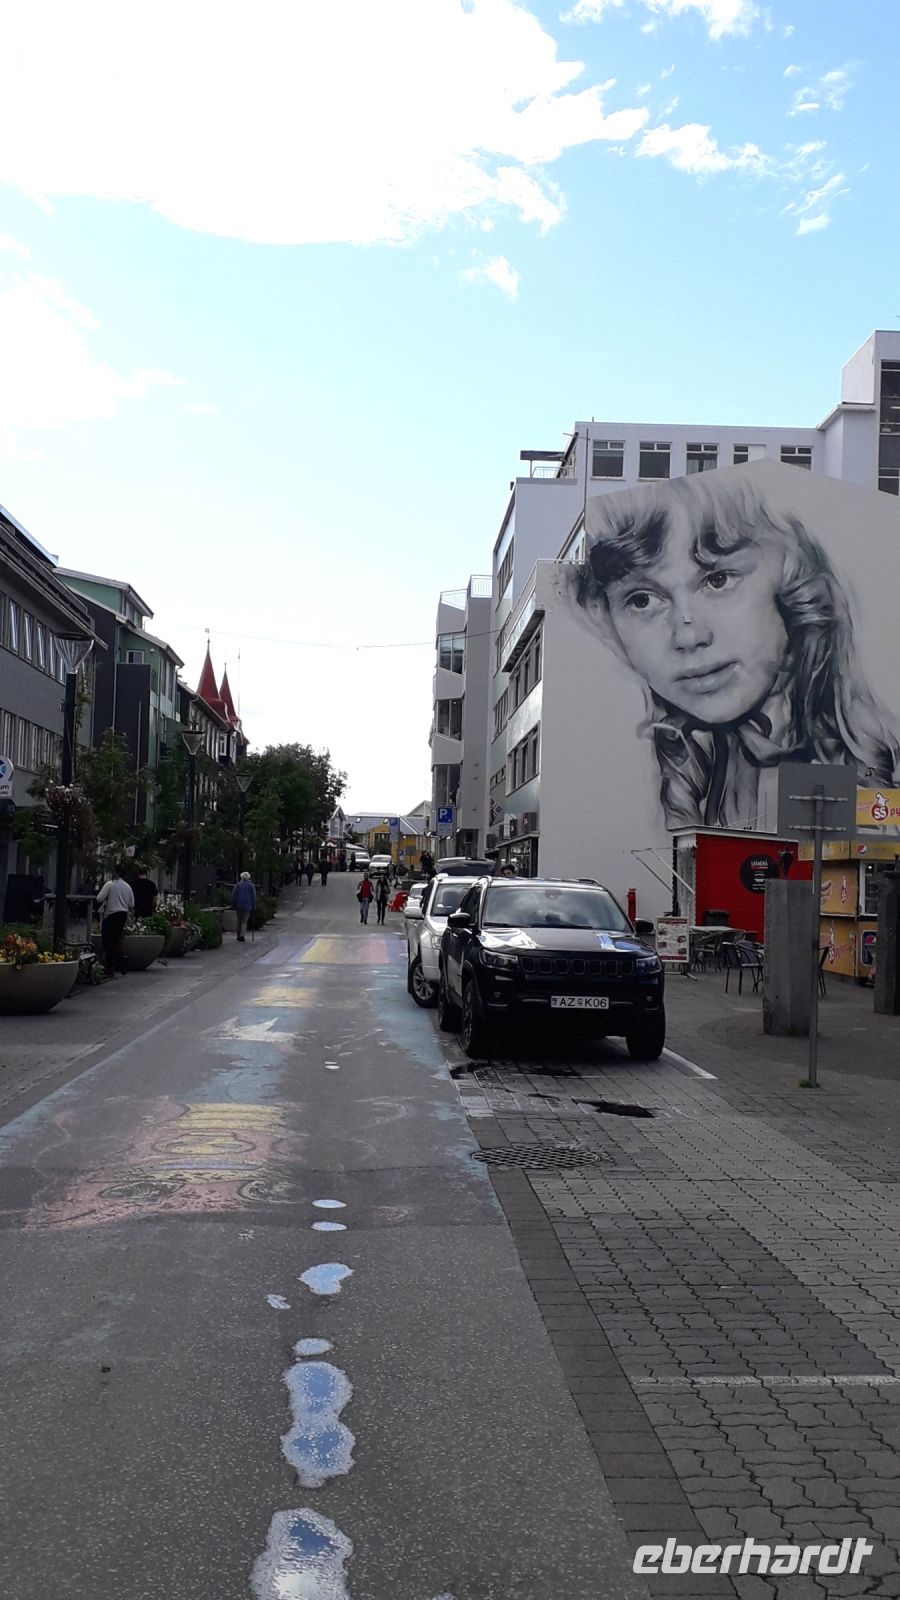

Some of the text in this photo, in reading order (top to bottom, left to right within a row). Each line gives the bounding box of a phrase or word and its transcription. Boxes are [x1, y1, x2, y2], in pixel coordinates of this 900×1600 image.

[439, 808, 448, 819] P
[873, 806, 887, 819] SS
[559, 997, 576, 1007] AZ
[584, 998, 607, 1008] K06
